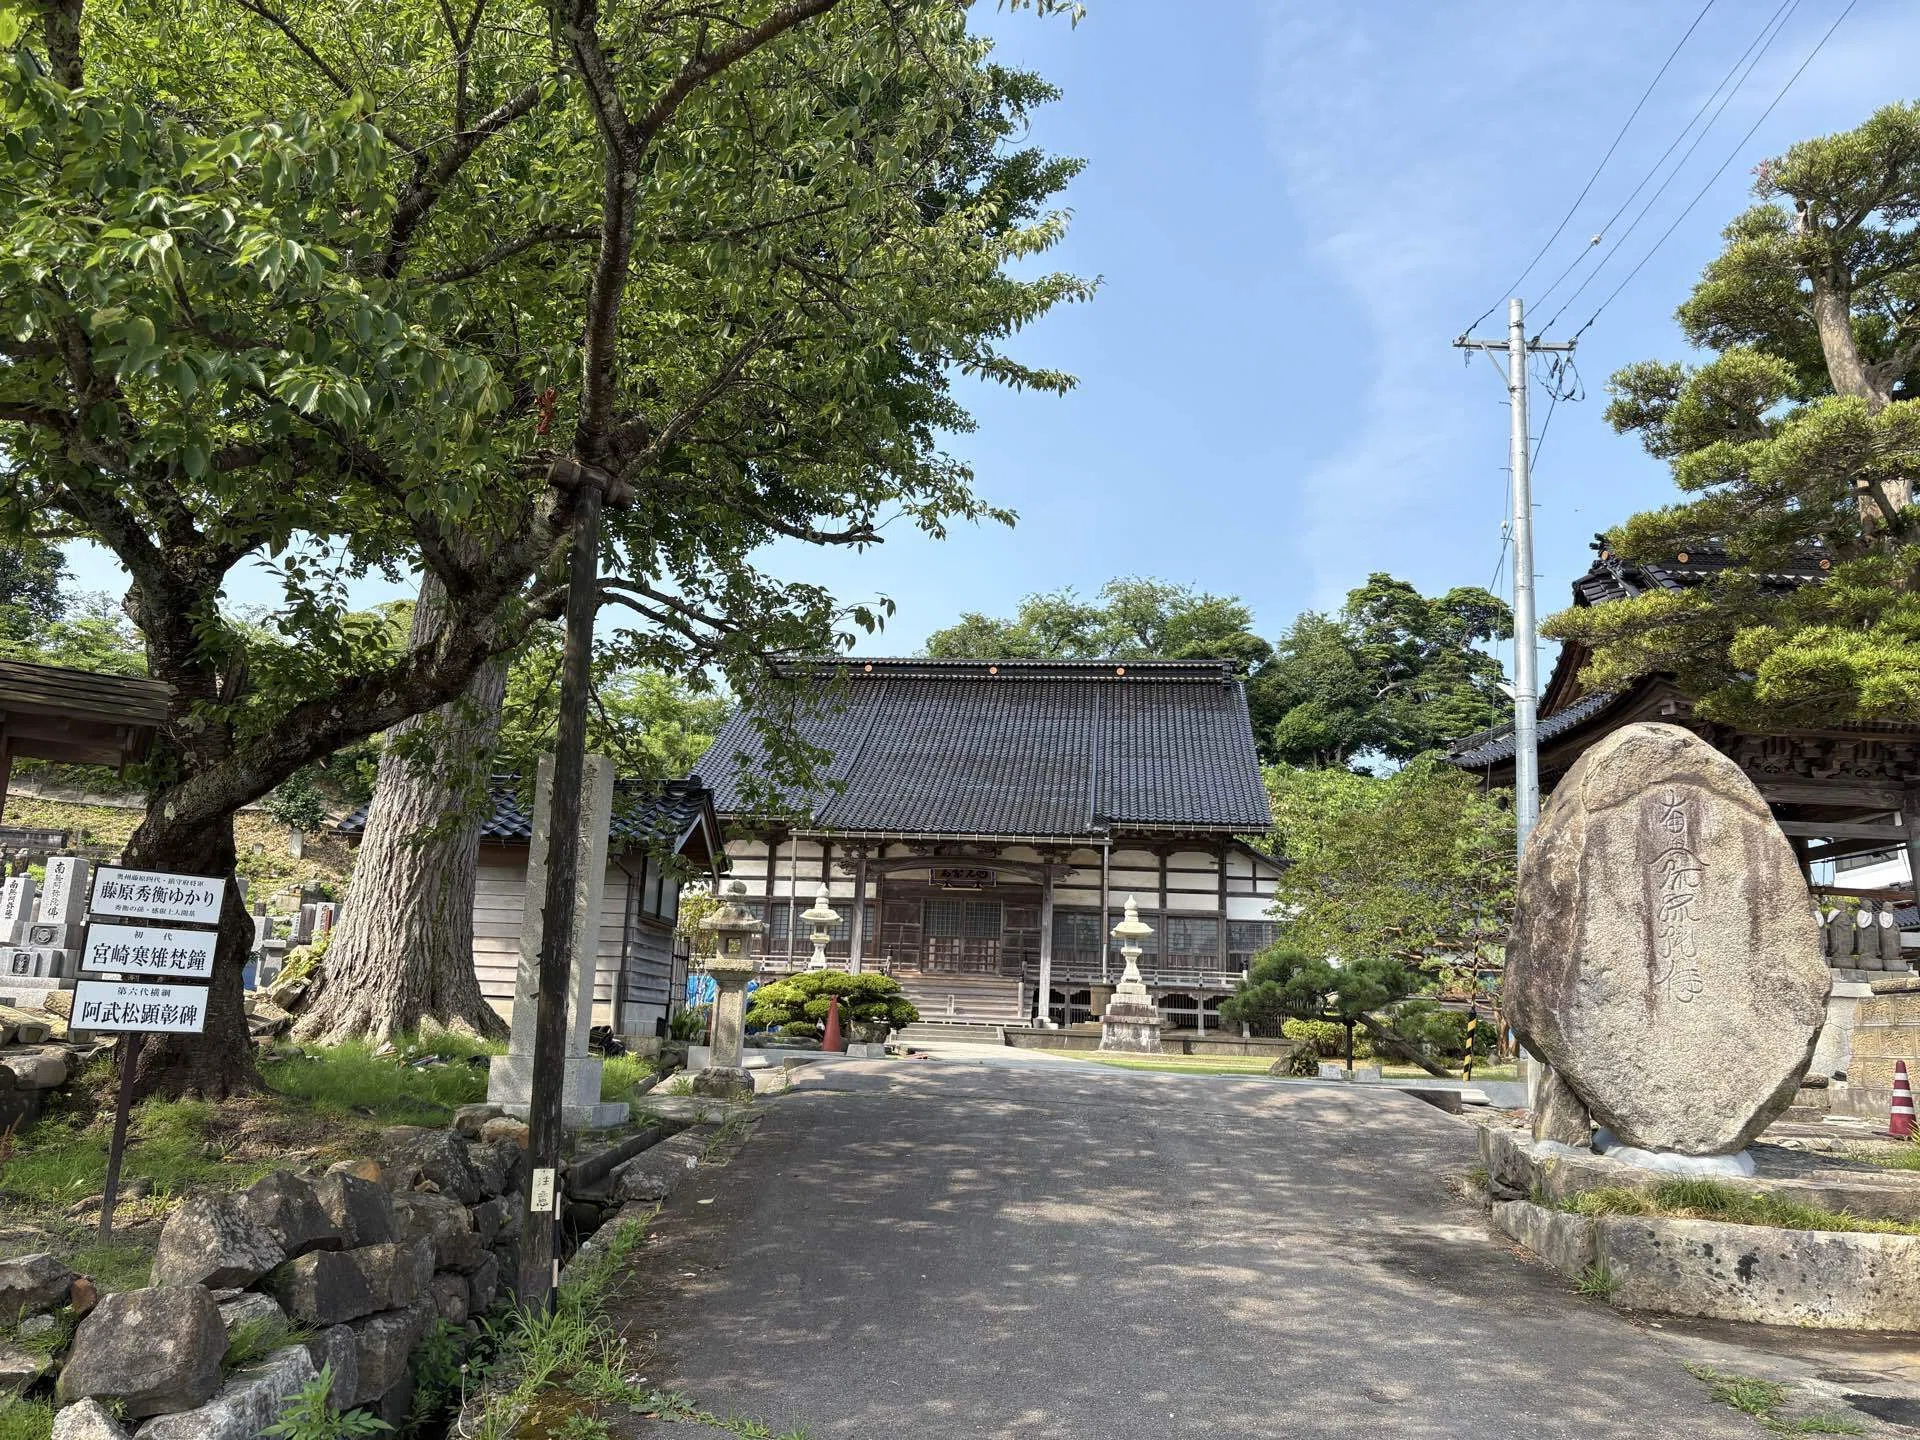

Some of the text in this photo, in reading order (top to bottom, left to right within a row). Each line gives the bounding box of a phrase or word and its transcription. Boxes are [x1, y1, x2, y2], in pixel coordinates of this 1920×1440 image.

[100, 880, 215, 908] 藤原秀衡ゆかり
[92, 942, 207, 971] 宮崎寒雉梵鐘
[117, 986, 171, 998] 第六代横綱
